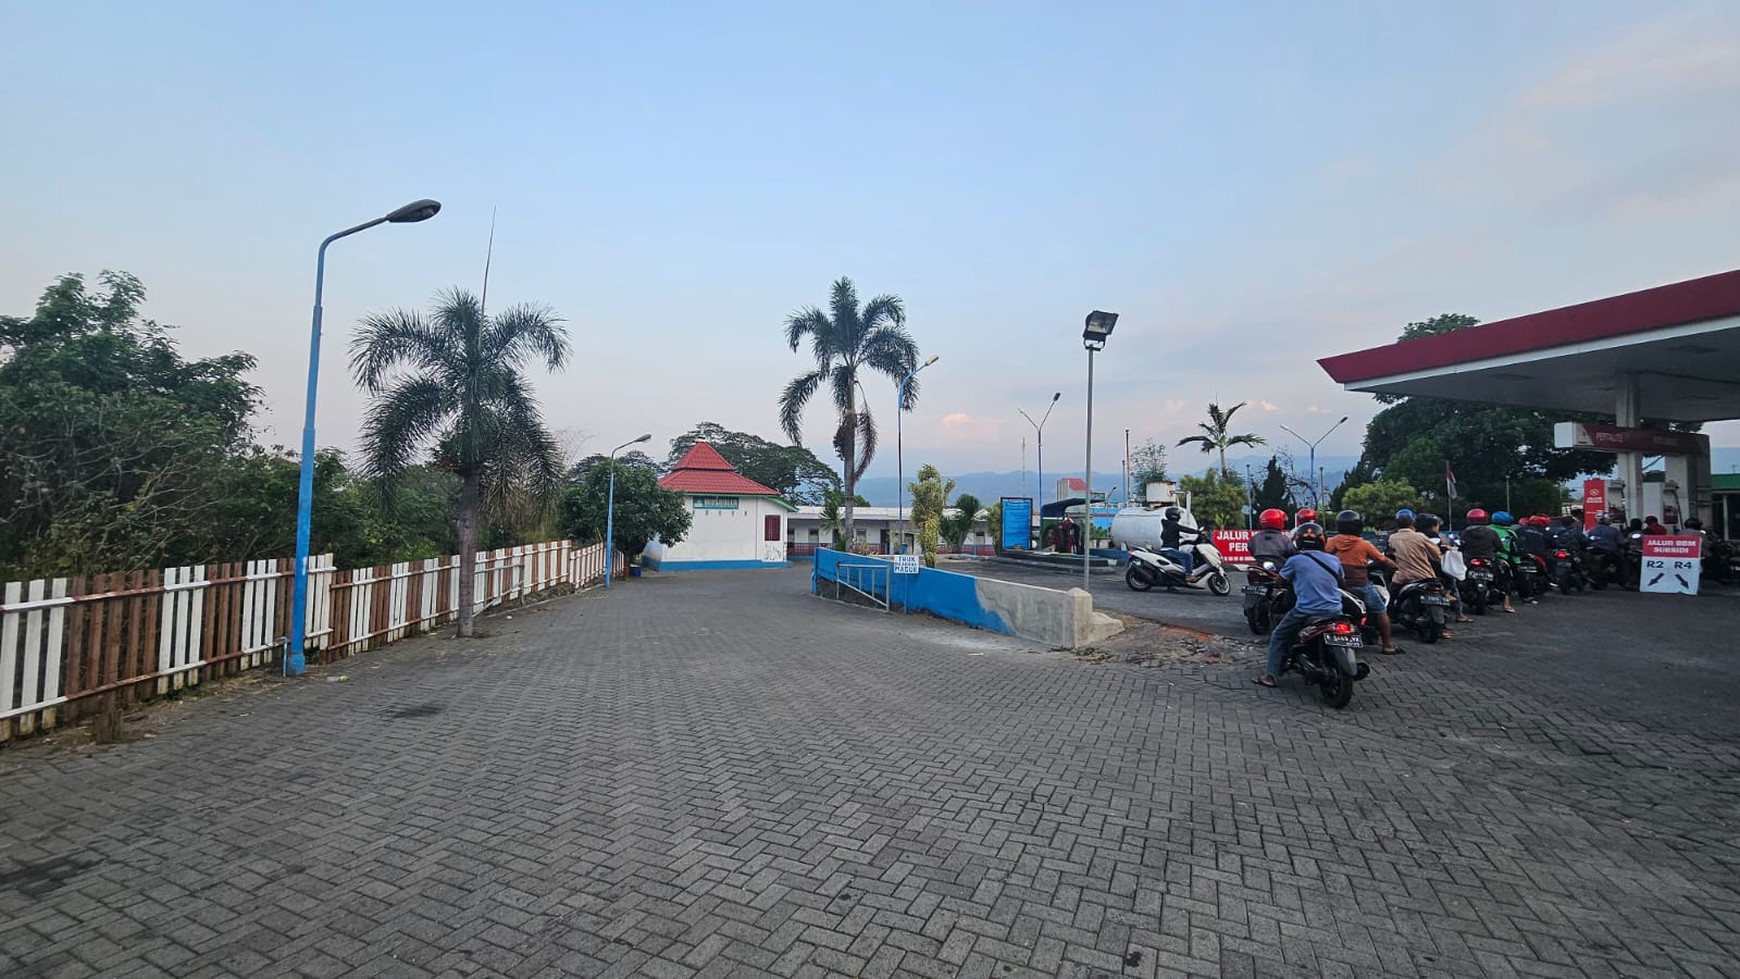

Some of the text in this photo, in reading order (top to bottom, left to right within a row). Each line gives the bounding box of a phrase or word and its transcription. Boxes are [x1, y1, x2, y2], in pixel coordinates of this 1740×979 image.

[1216, 530, 1249, 540] JALUR
[1646, 560, 1692, 569] R2 R4
